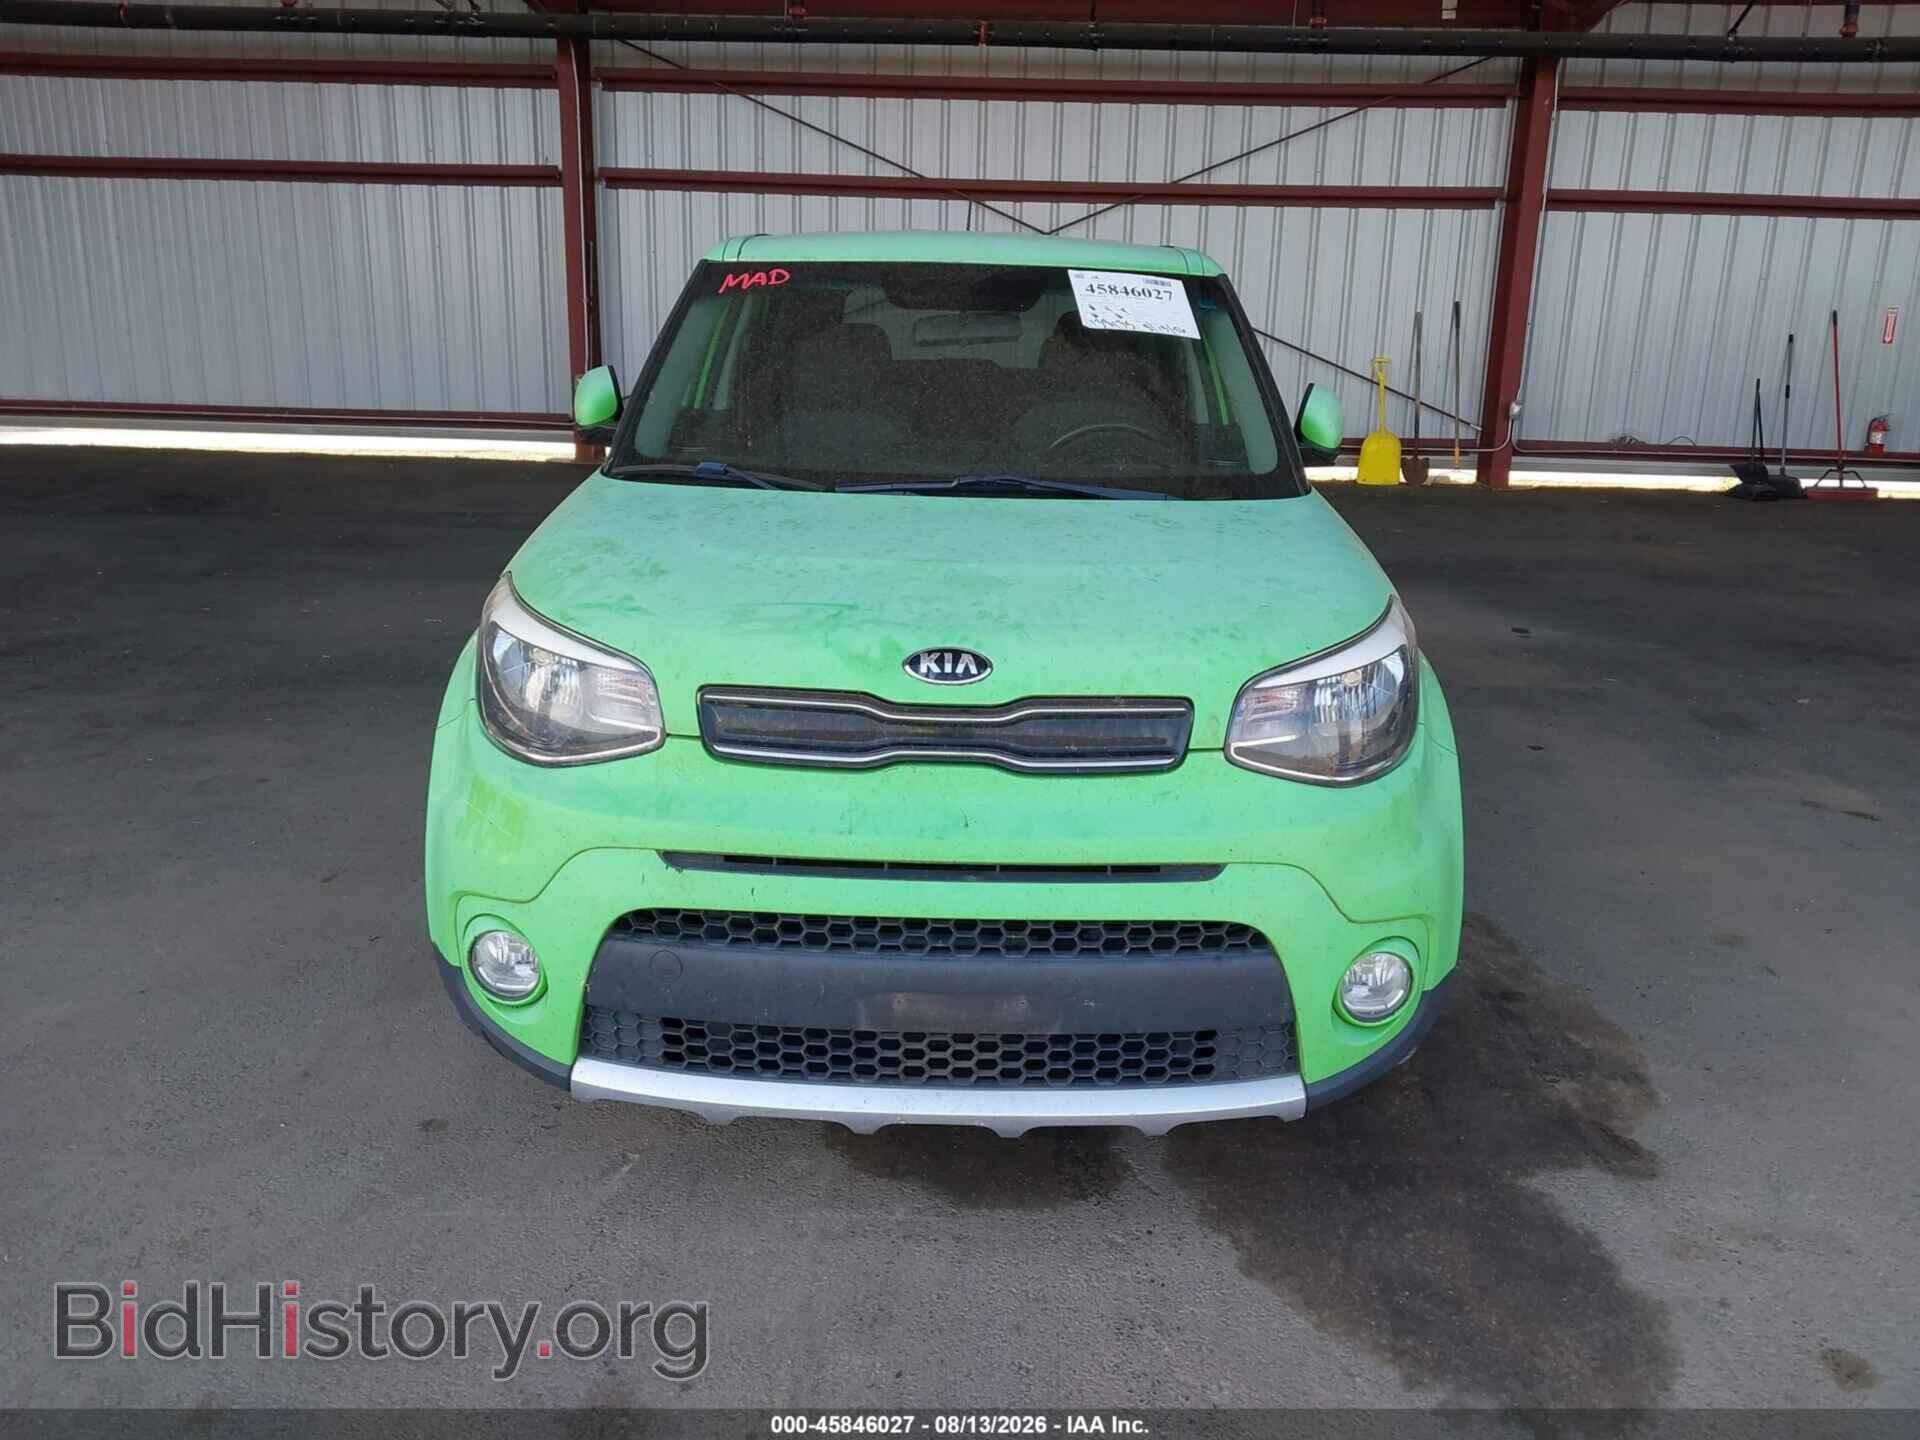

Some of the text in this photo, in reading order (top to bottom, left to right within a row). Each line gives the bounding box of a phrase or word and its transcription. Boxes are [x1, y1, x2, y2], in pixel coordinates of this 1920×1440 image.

[718, 268, 790, 293] MAD
[1085, 283, 1172, 301] 45846027
[920, 653, 978, 674] KIA
